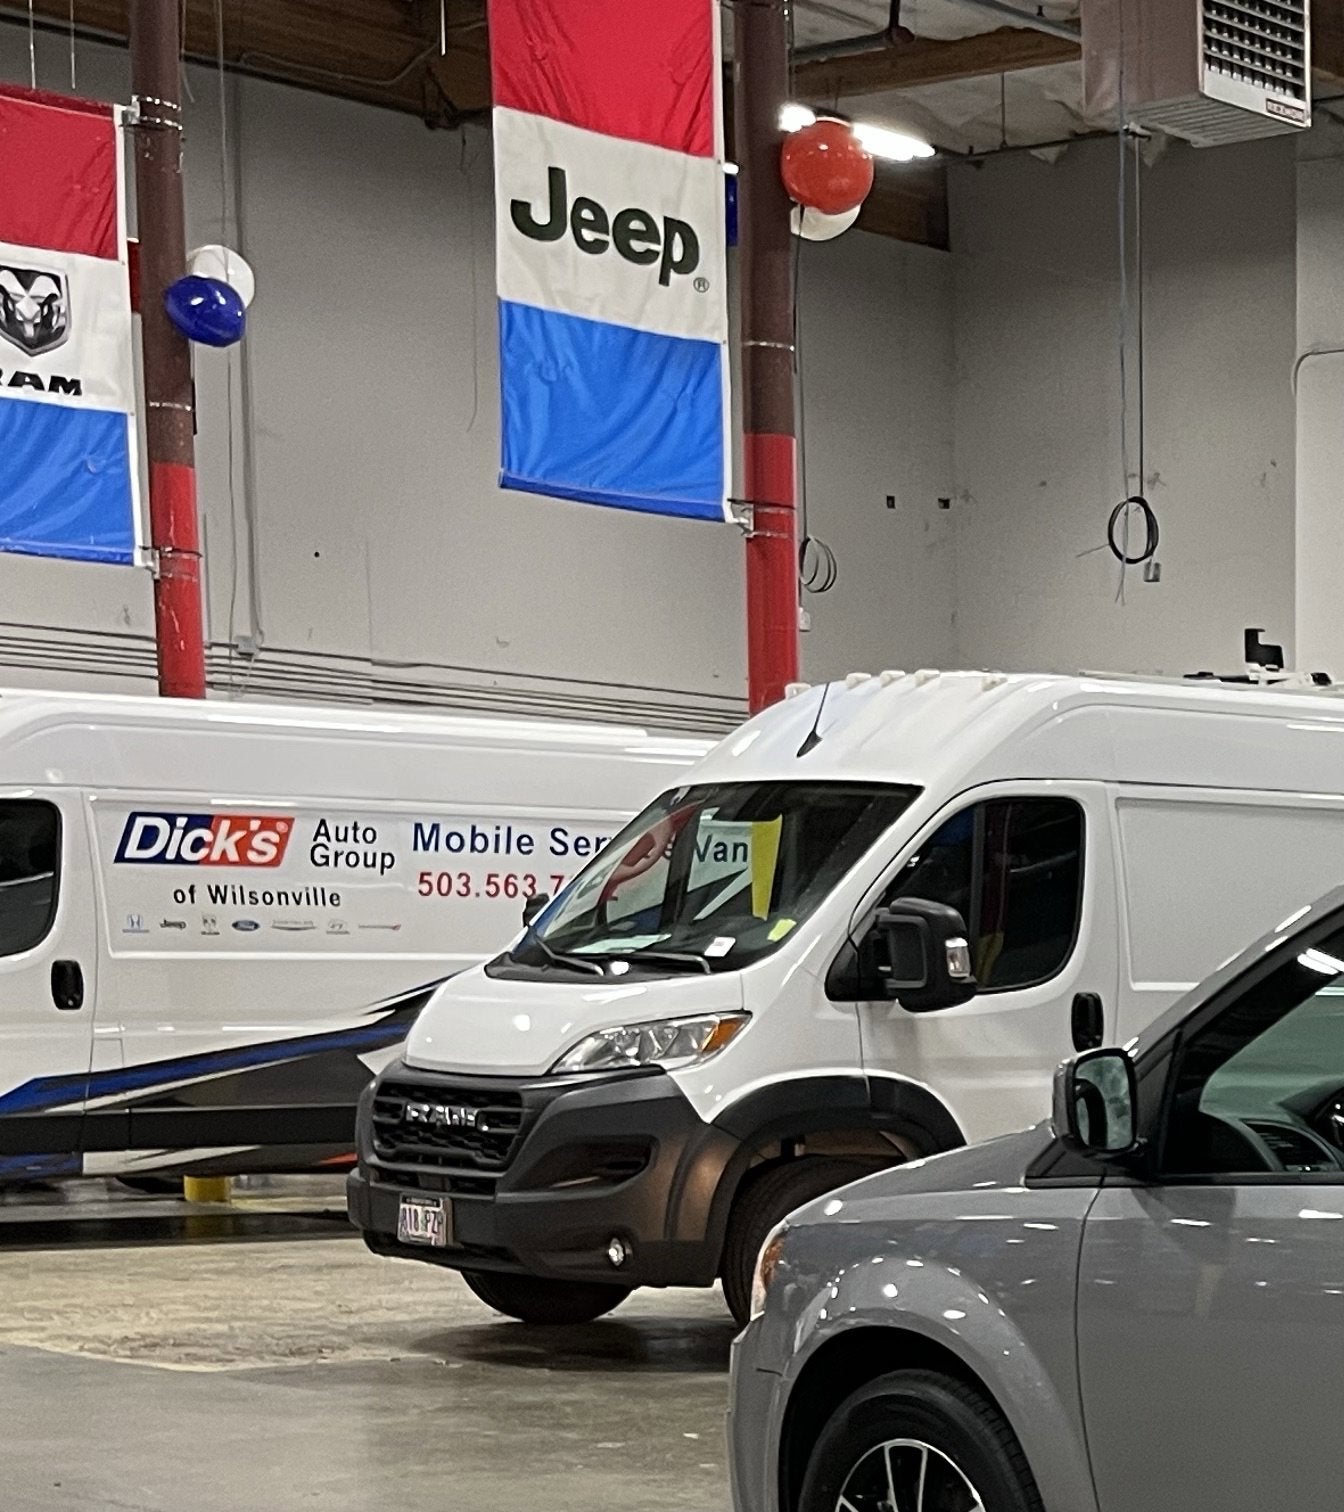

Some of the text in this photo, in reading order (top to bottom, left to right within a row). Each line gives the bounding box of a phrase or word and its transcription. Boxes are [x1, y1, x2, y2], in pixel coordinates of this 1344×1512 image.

[510, 166, 700, 287] Jeep
[0, 367, 82, 396] AM
[313, 819, 378, 845] Auto
[412, 822, 535, 856] Mobile
[310, 843, 396, 877] Group
[173, 884, 342, 907] of Wilsonville
